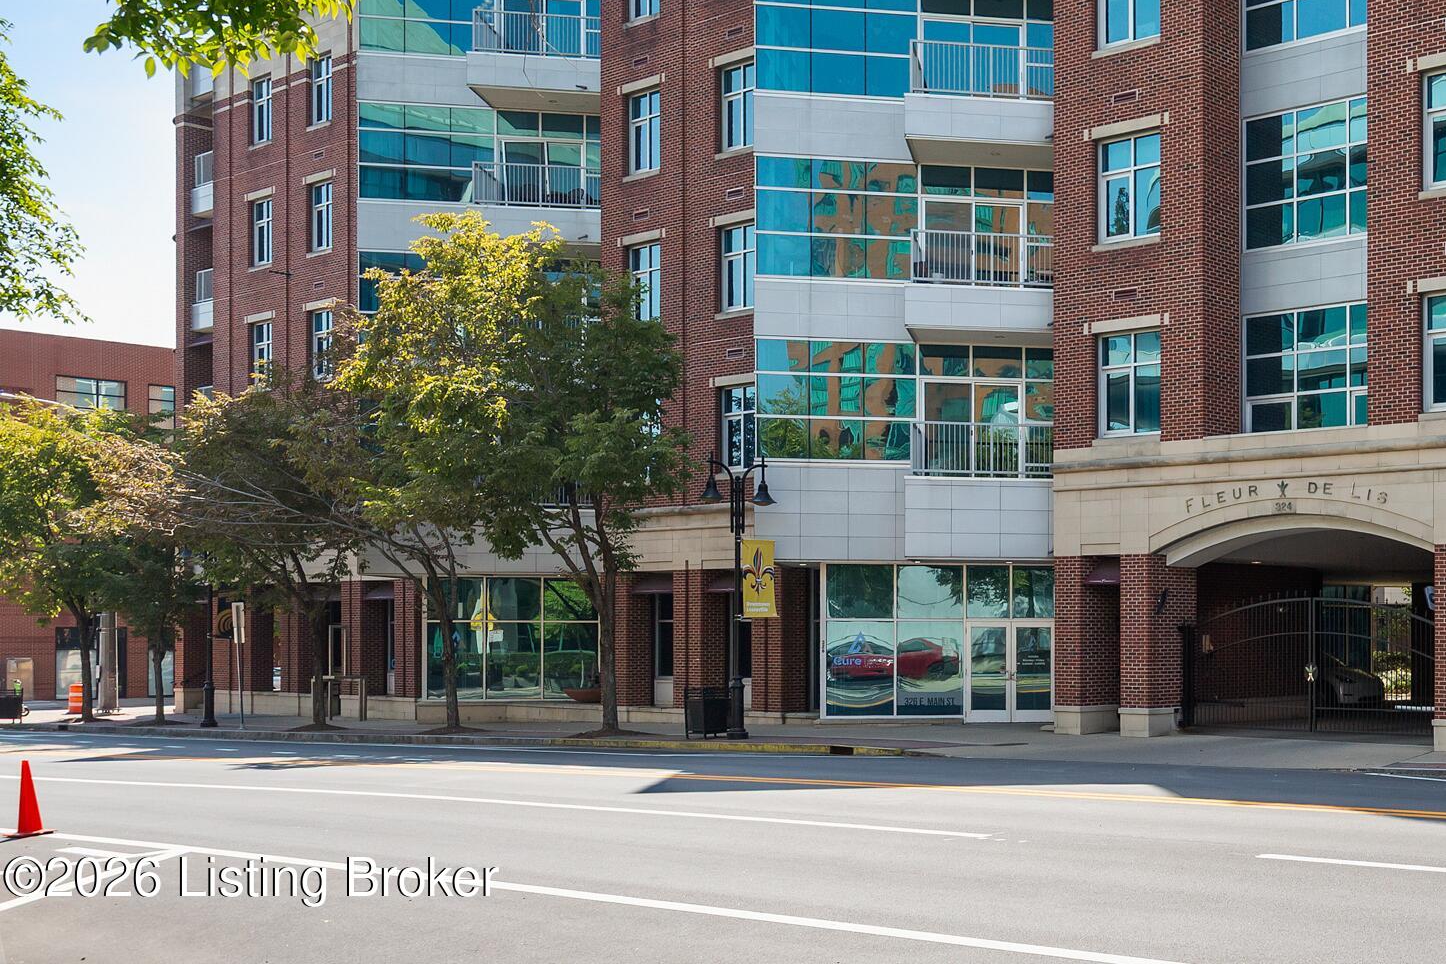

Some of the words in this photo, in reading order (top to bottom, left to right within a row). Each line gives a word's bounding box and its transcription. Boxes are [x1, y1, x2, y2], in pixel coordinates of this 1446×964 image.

[1185, 485, 1259, 513] FLEUR
[1307, 481, 1334, 495] DE
[1350, 482, 1388, 505] LIS
[1274, 501, 1293, 511] 324
